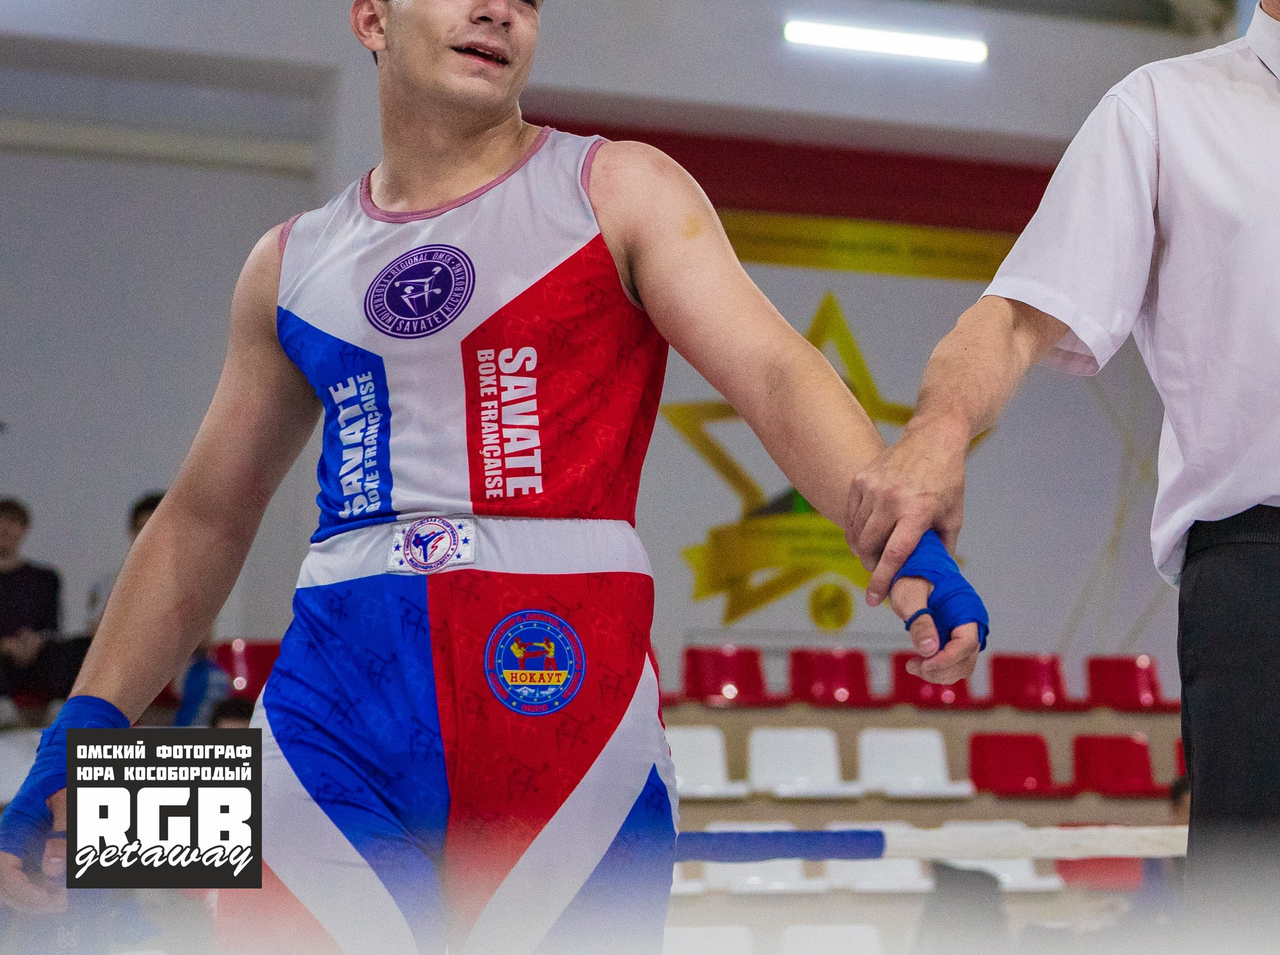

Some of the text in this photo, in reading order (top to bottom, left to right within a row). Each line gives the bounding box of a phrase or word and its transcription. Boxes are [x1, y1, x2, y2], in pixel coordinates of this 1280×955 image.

[373, 263, 466, 333] FEDERATION SAVATE KICKBOXING
[390, 252, 455, 276] REGIONAL OMSK
[328, 376, 367, 519] SAVATE
[356, 371, 380, 513] BOXE FRANÇAISE
[476, 348, 504, 499] BOXE FRANÇAISE
[498, 346, 544, 497] SAVATE
[510, 672, 562, 683] НОКАУТ
